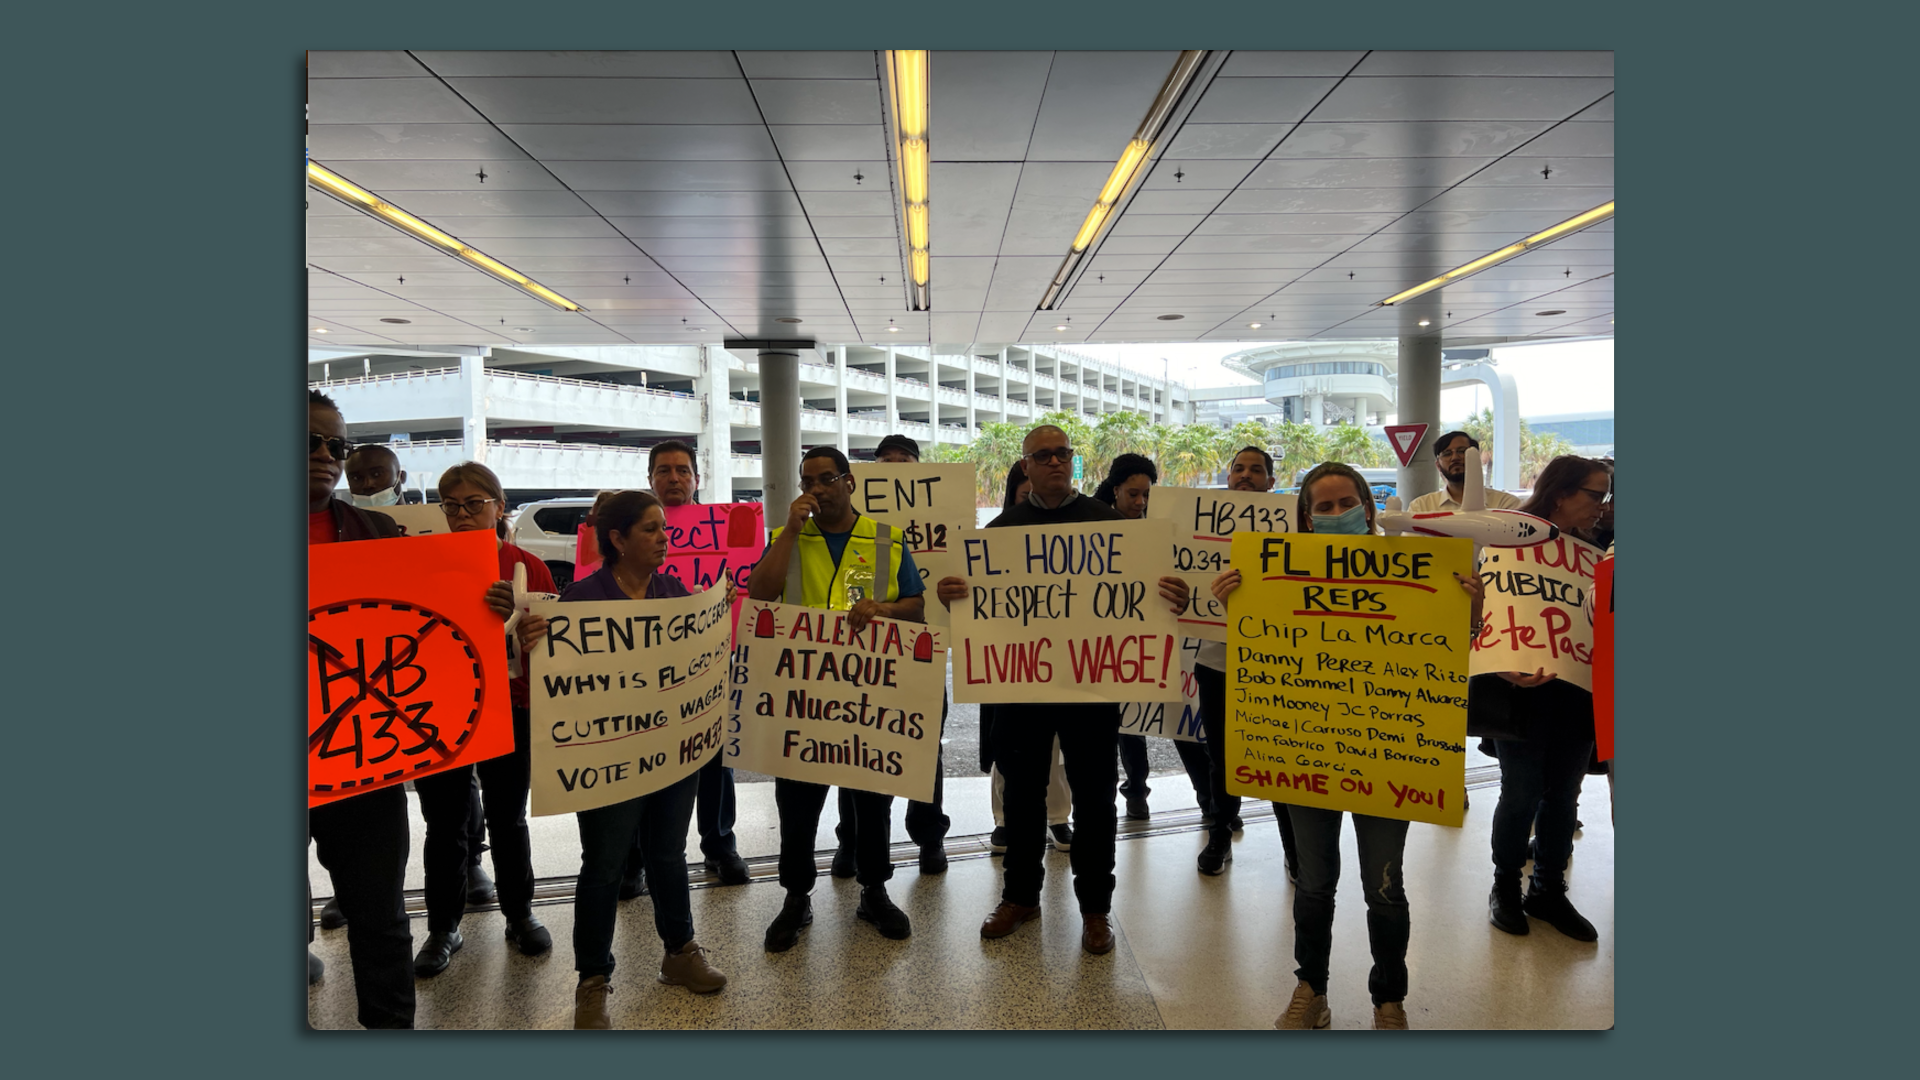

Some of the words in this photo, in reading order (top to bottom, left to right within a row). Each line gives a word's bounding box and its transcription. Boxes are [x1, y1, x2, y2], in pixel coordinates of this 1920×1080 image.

[850, 476, 941, 516] ENT
[667, 506, 725, 550] ect
[964, 539, 1011, 576] FL.
[1025, 532, 1123, 575] HOUSE
[1260, 538, 1311, 576] FL
[1326, 544, 1434, 580] HOUSE
[1093, 580, 1147, 621] OUR
[1303, 585, 1388, 612] REPS
[546, 615, 660, 657] RENT
[789, 612, 904, 656] ALERTA
[1238, 615, 1308, 648] Chip
[1321, 621, 1356, 643] La
[1365, 624, 1453, 652] Marca
[1539, 607, 1594, 665] Pas
[317, 634, 427, 715] HB
[543, 674, 610, 698] WHY
[658, 665, 686, 688] FL
[775, 648, 897, 688] ATAQUE
[964, 637, 1053, 685] LIVING
[1068, 634, 1174, 689] WAGE!
[1238, 646, 1303, 674] Danny
[1383, 662, 1419, 679] Alex
[1424, 663, 1468, 684] Rizo
[1235, 688, 1270, 706] Jim
[1273, 694, 1330, 721] Mooney
[1337, 702, 1365, 716] JC
[1370, 705, 1425, 728] Porras
[1237, 668, 1275, 685] Bob
[1281, 672, 1355, 694] Rommel
[1363, 681, 1411, 708] Danny
[1416, 688, 1468, 709] Alvarez
[318, 701, 439, 769] 433
[552, 710, 668, 743] CUTTING
[755, 692, 774, 717] a
[785, 689, 924, 740] Nuestras
[1235, 709, 1298, 734] Michael
[1301, 720, 1361, 737] Carruso
[1366, 727, 1405, 743] Demi
[557, 761, 631, 792] VOTE
[639, 752, 666, 774] NO
[679, 716, 722, 765] HB433
[783, 730, 903, 776] Familias
[1235, 729, 1269, 743] Tom
[1336, 741, 1377, 760] David
[1384, 749, 1440, 766] Borrero
[1244, 748, 1286, 765] Alina
[1296, 754, 1363, 776] Garcia
[1235, 766, 1329, 795] SHAME
[1340, 778, 1373, 796] ON
